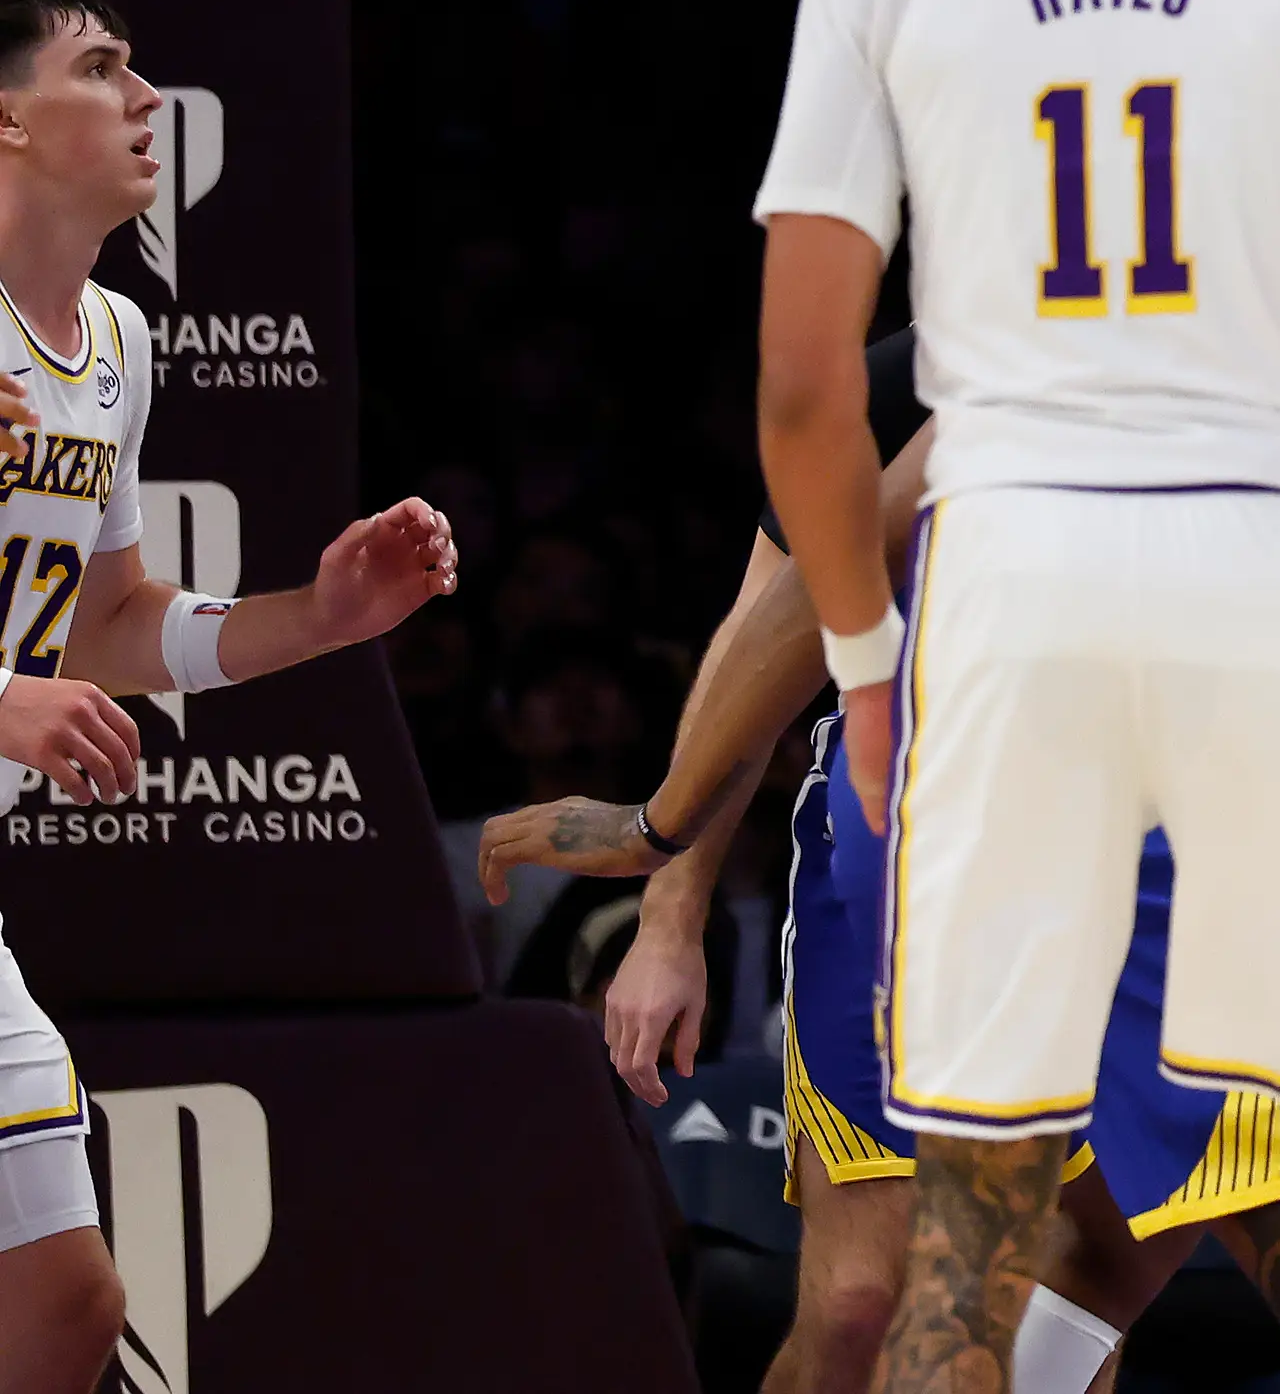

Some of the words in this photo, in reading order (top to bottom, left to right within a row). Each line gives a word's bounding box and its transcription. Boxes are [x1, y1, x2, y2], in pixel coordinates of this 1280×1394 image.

[1033, 77, 1199, 319] 11
[191, 359, 320, 389] CASINO
[0, 533, 85, 679] 12
[7, 811, 178, 845] RESORT
[203, 809, 367, 843] CASINO
